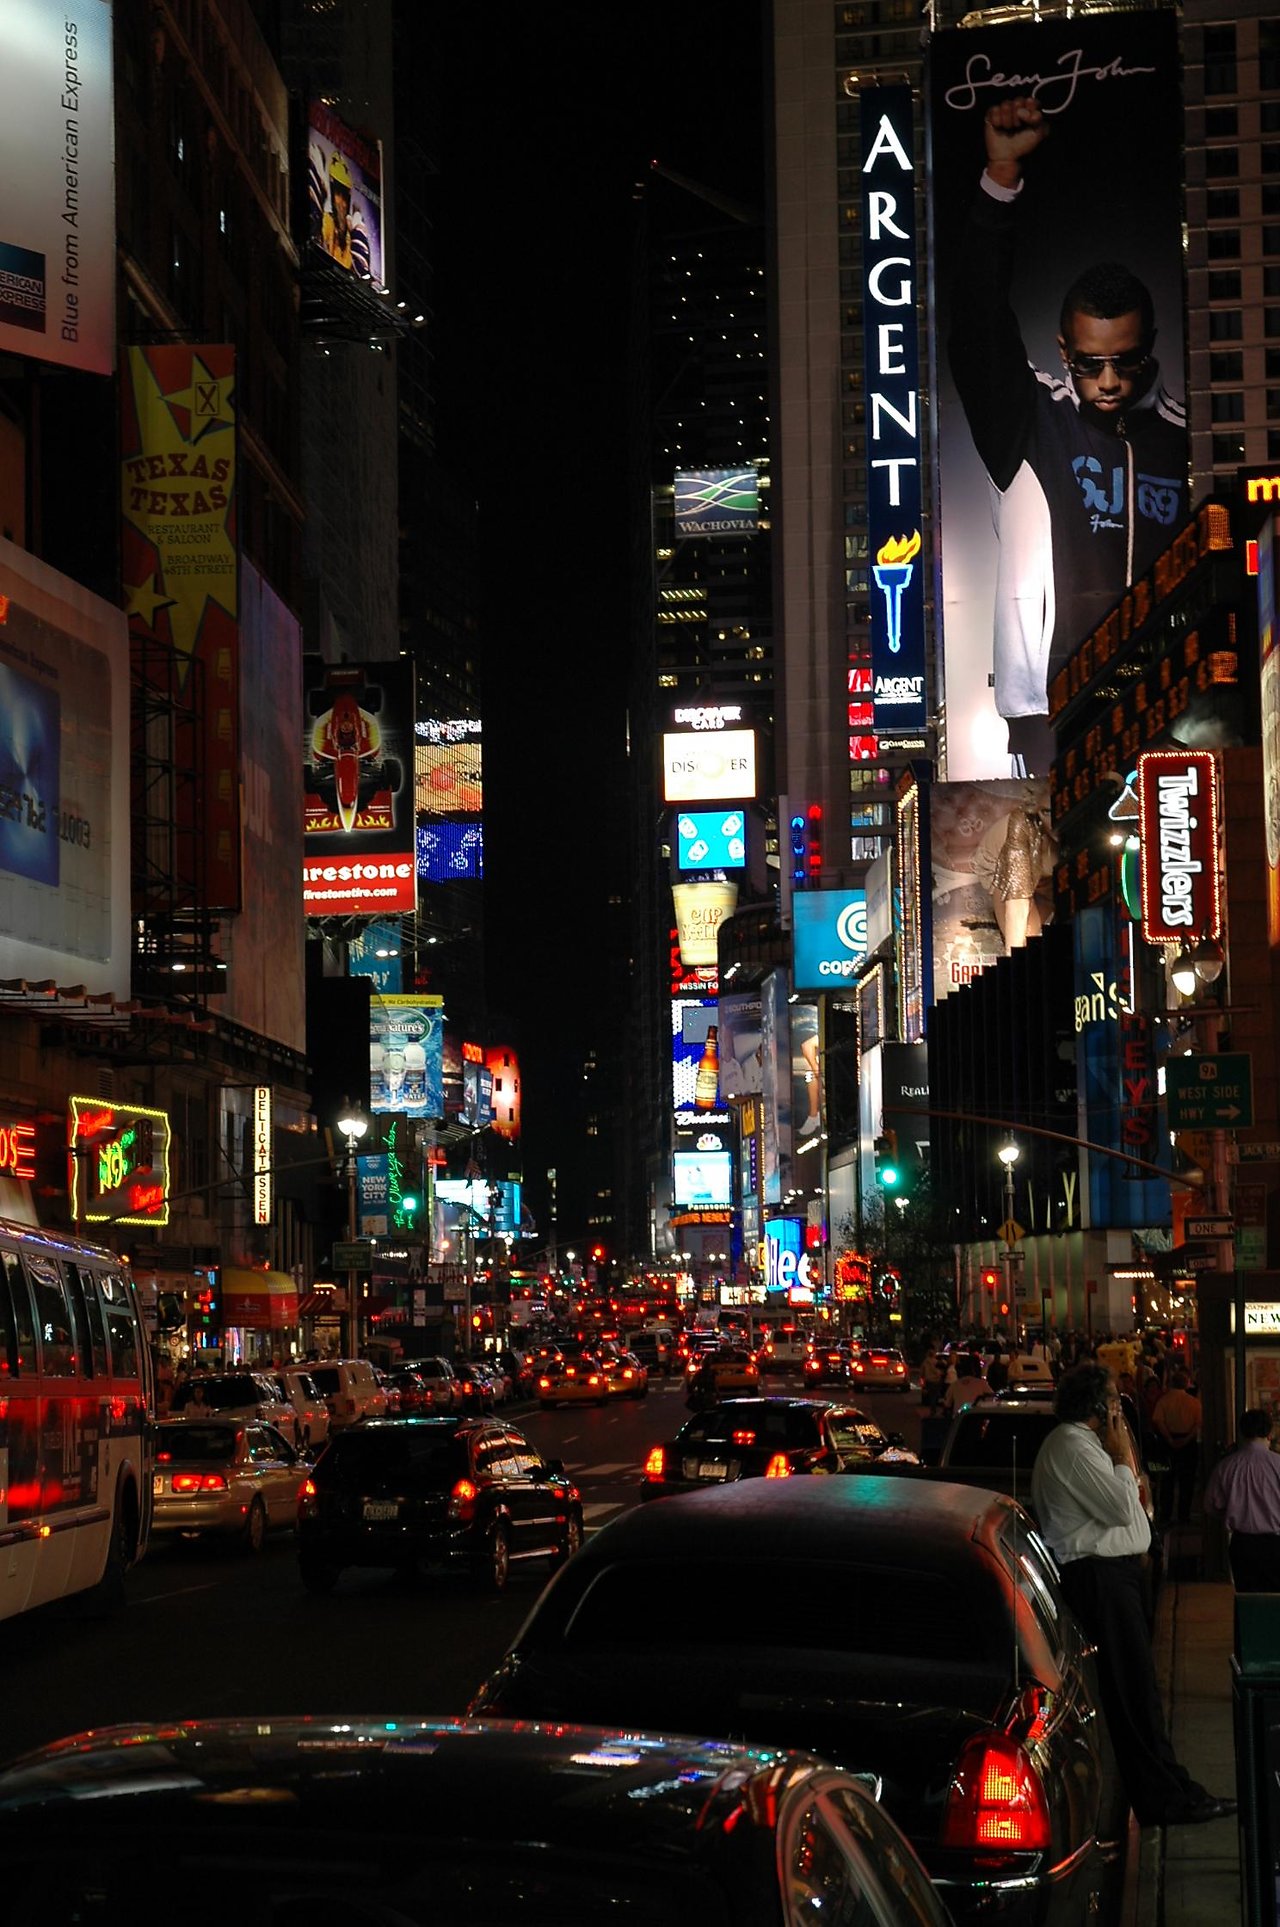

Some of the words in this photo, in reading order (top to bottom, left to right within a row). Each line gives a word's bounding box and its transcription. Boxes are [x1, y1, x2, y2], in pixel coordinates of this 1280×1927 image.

[62, 22, 84, 113] Express
[945, 53, 1042, 110] Sean
[1041, 48, 1156, 114] John
[61, 119, 79, 227] American
[61, 235, 79, 287] from
[61, 293, 79, 343] Blue
[863, 114, 918, 508] ARGENT
[127, 453, 230, 484] TEXAS
[130, 485, 227, 516] TEXAS
[147, 523, 220, 535] RESTAURANT
[679, 520, 755, 532] WACHOVIA
[167, 534, 212, 545] SALOON
[167, 554, 230, 565] BROADWAY
[197, 564, 234, 575] STREET
[875, 676, 924, 694] ARGENT
[672, 758, 748, 773] DISER
[1158, 767, 1202, 926] Twizzlers
[951, 962, 984, 983] GAR
[679, 982, 706, 990] NISSIN
[1177, 1087, 1207, 1101] WEST
[1213, 1085, 1240, 1100] SIDE
[1179, 1107, 1205, 1120] HWY
[363, 1191, 386, 1200] CITY
[1195, 1224, 1217, 1233] ONE
